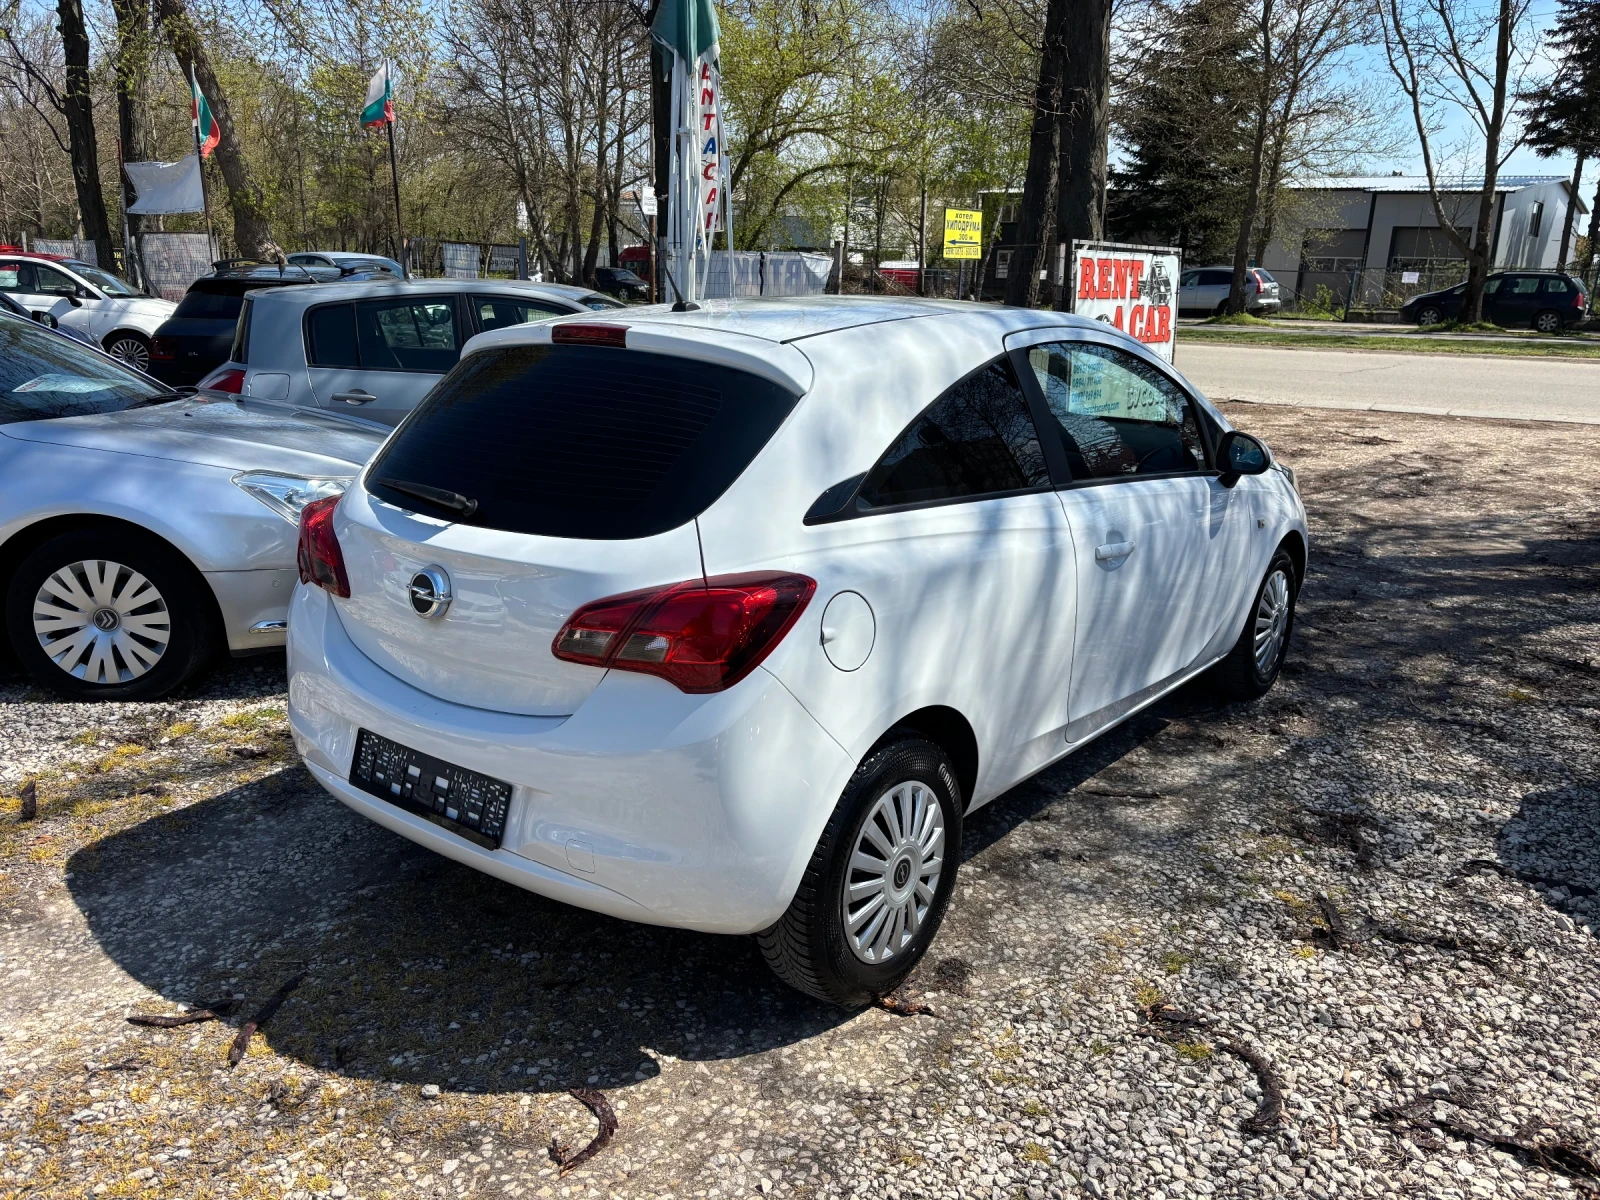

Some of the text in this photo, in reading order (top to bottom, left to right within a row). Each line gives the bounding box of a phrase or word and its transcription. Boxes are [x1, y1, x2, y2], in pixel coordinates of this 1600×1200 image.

[701, 62, 716, 131] ENT
[946, 220, 980, 232] ХИПОДРУМА
[1078, 257, 1144, 300] RENT
[1129, 304, 1171, 343] CAR
